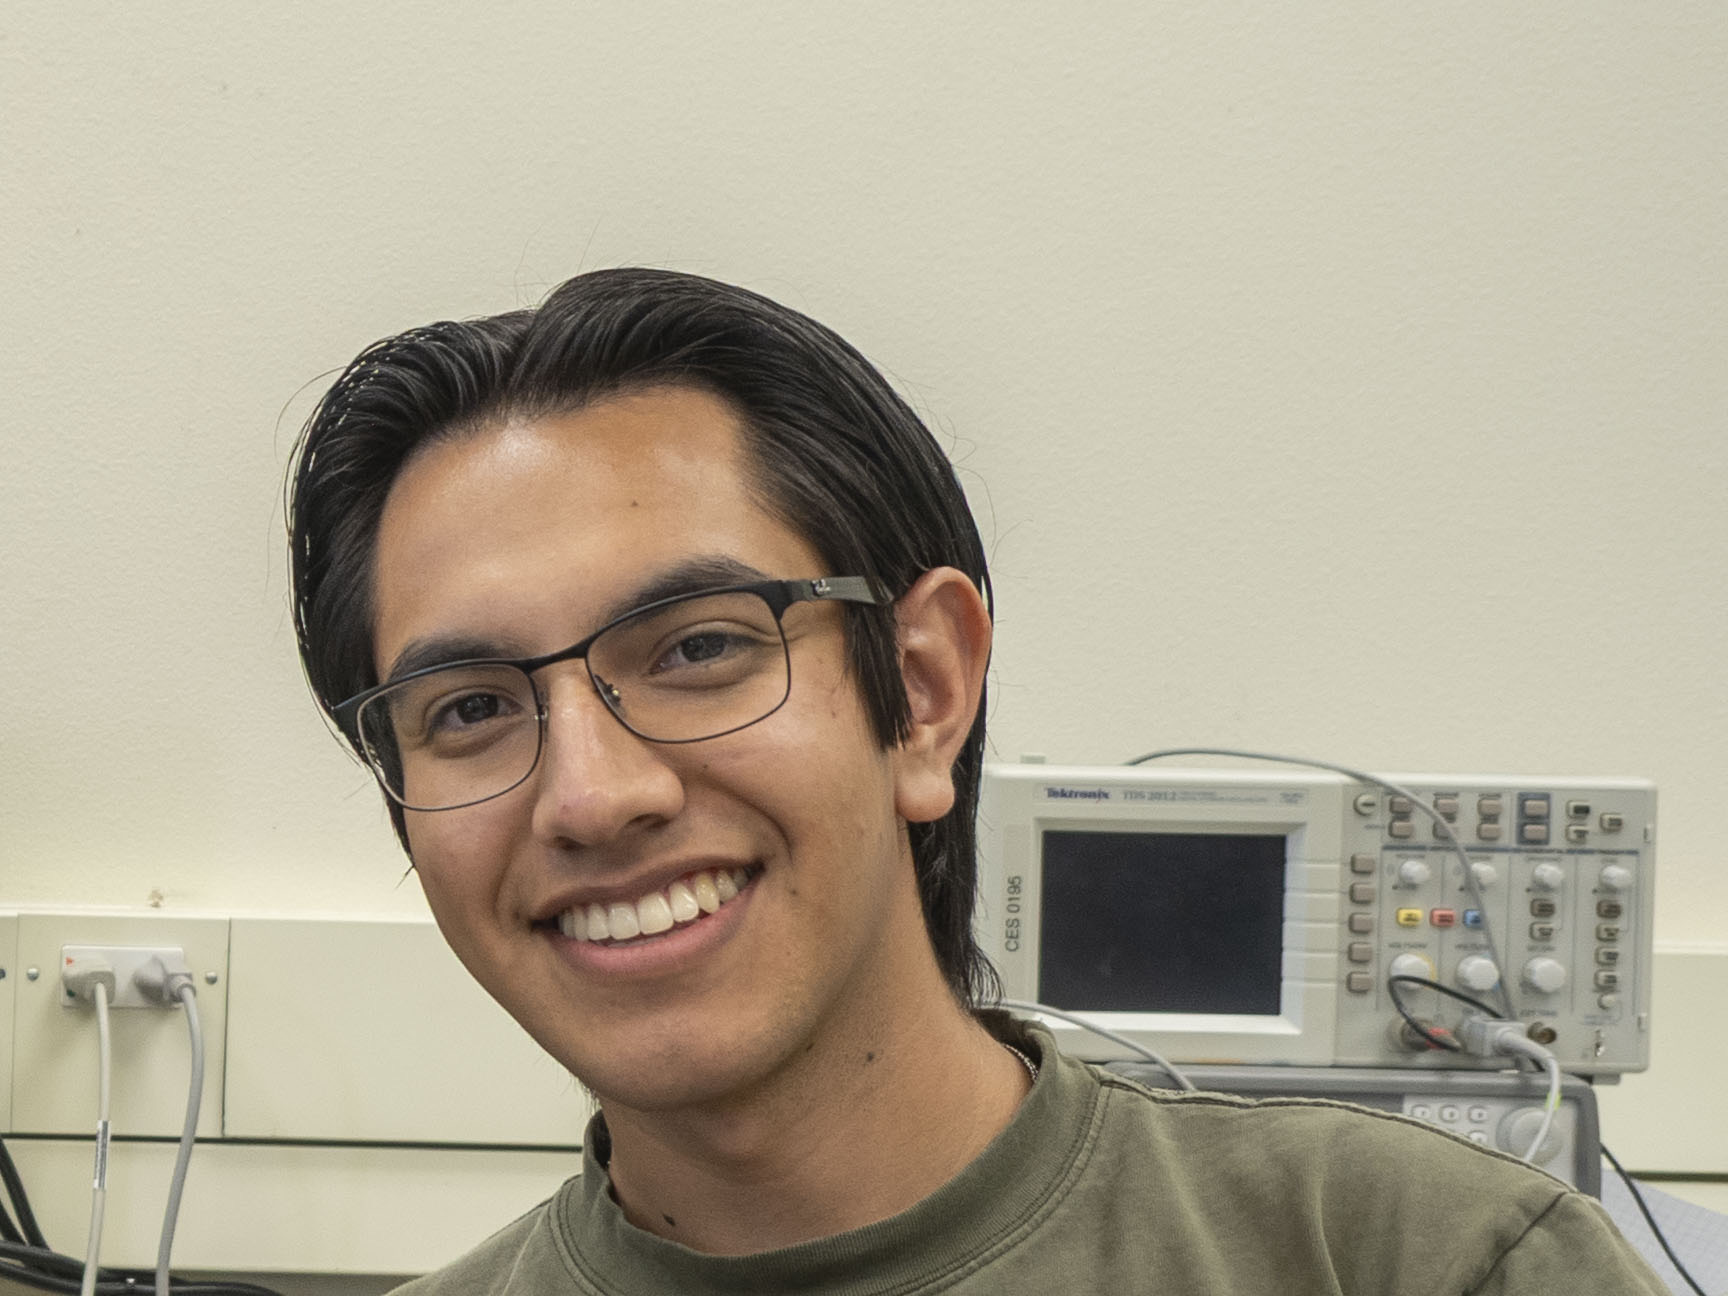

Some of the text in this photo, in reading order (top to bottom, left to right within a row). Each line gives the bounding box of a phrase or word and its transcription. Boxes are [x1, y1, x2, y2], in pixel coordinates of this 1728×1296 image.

[1046, 787, 1110, 802] Tektronix
[1004, 875, 1023, 953] CES 0195
